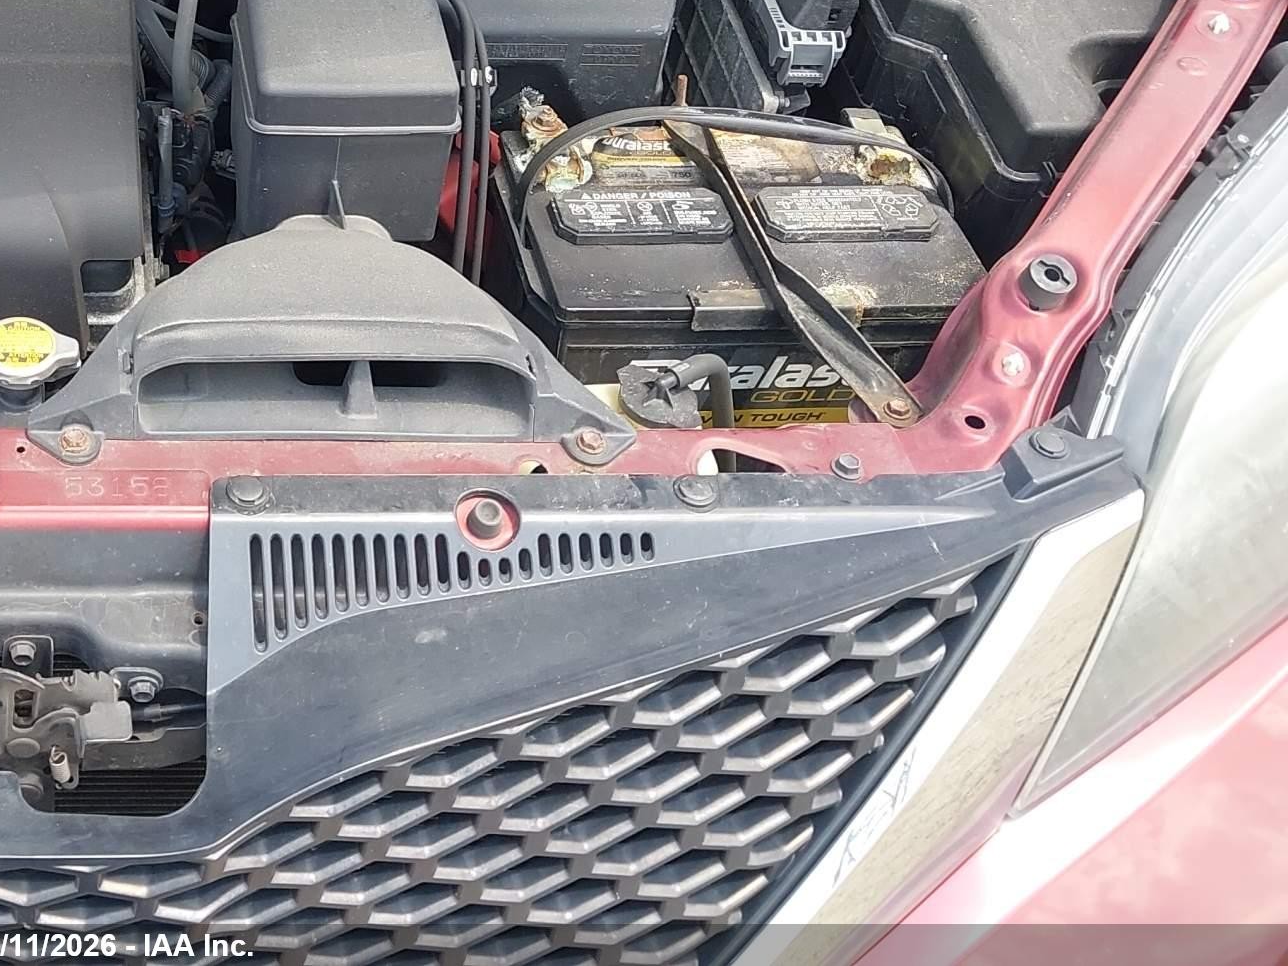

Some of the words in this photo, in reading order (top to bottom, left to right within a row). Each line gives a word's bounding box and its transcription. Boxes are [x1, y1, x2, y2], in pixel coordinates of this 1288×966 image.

[592, 192, 638, 200] DANGER
[649, 191, 691, 199] POISON
[750, 389, 856, 403] GOLD
[751, 412, 823, 422] TOUGH
